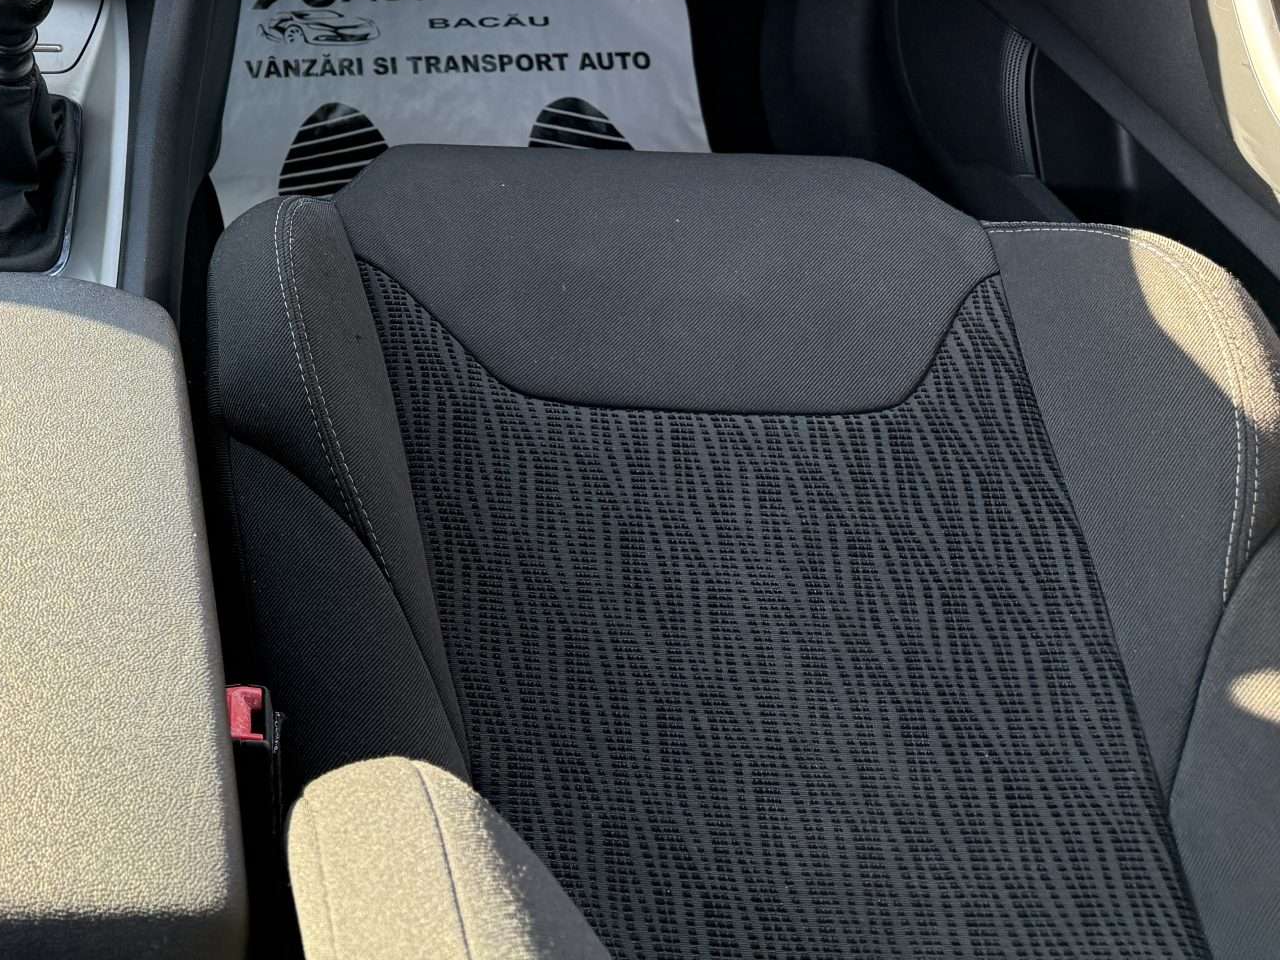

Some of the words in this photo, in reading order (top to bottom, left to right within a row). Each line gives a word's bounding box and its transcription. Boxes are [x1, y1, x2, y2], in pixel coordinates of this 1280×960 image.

[428, 13, 550, 30] BACĂU
[244, 53, 364, 79] VÂNZĂRI
[372, 56, 398, 76] SI
[406, 53, 568, 75] TRANSPORT
[578, 50, 652, 71] AUTO
